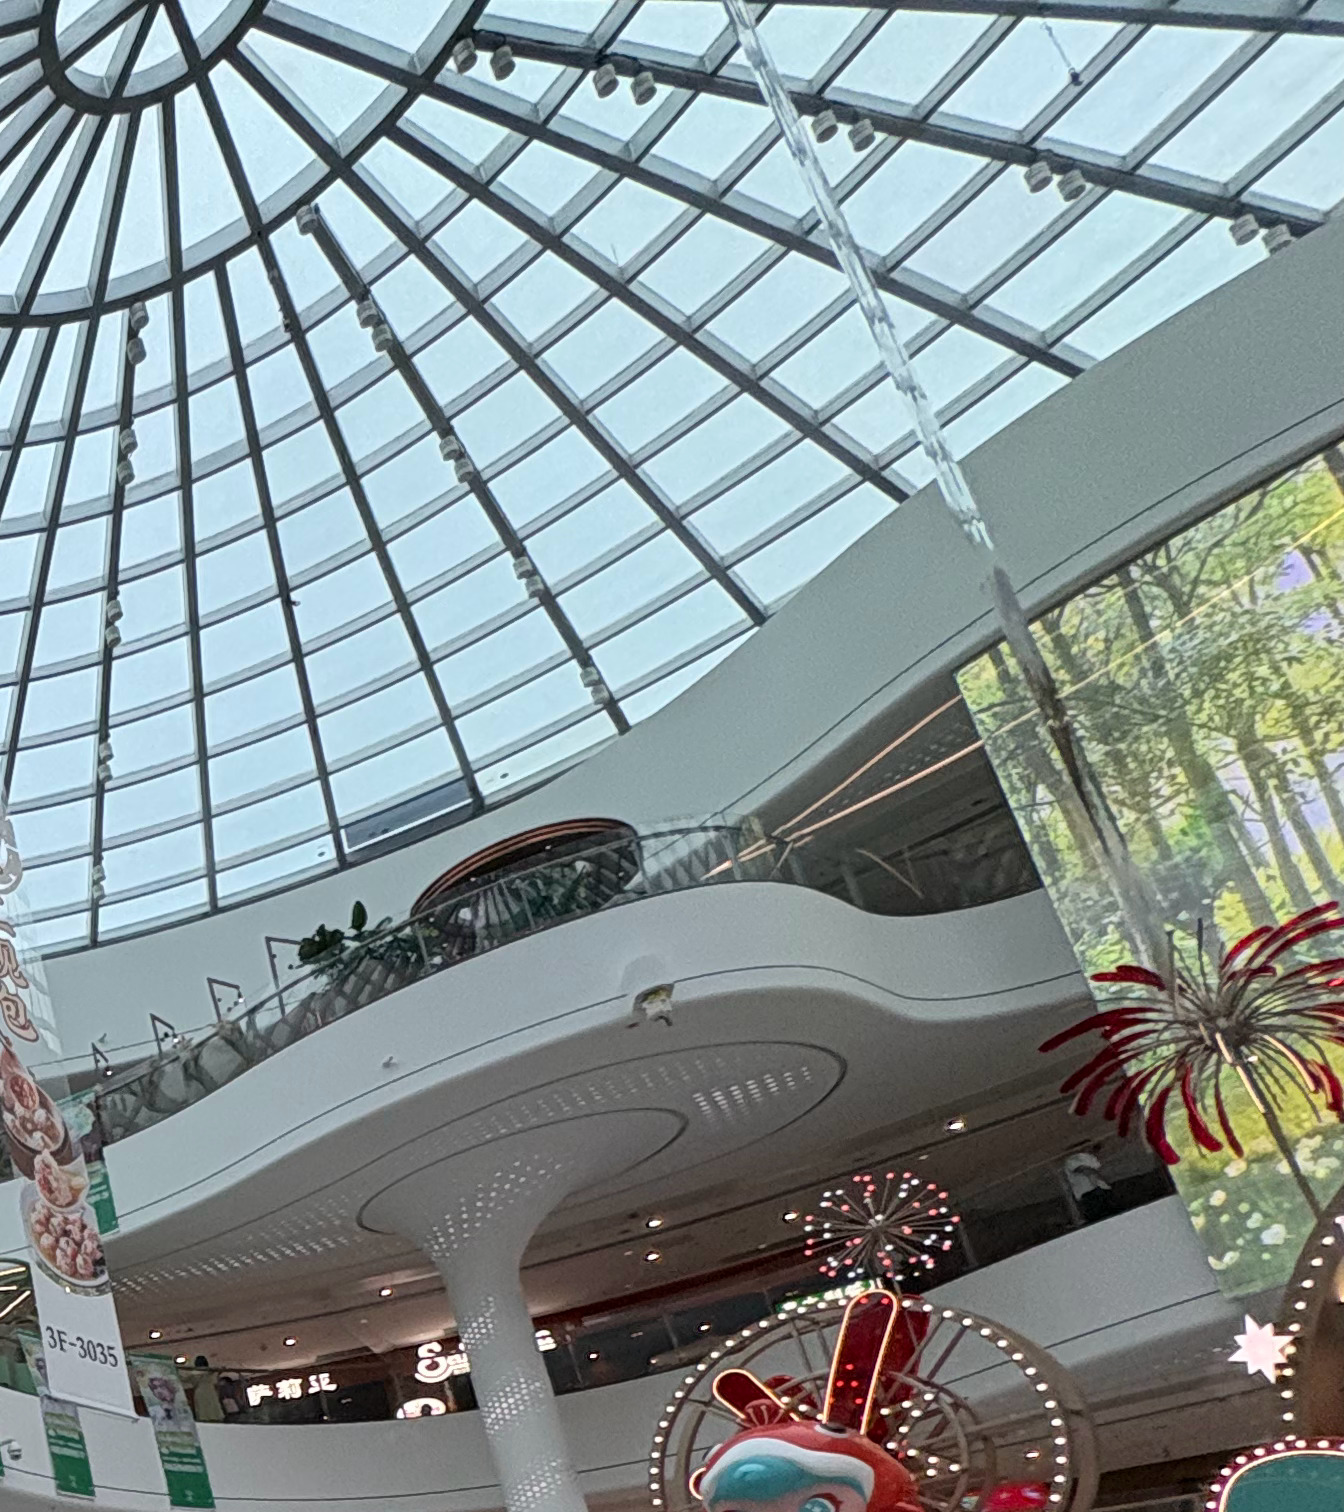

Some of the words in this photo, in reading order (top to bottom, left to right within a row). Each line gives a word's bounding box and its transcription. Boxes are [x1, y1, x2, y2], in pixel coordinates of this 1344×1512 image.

[45, 1325, 119, 1368] 3F-3035
[246, 1372, 338, 1407] 萨莉亚
